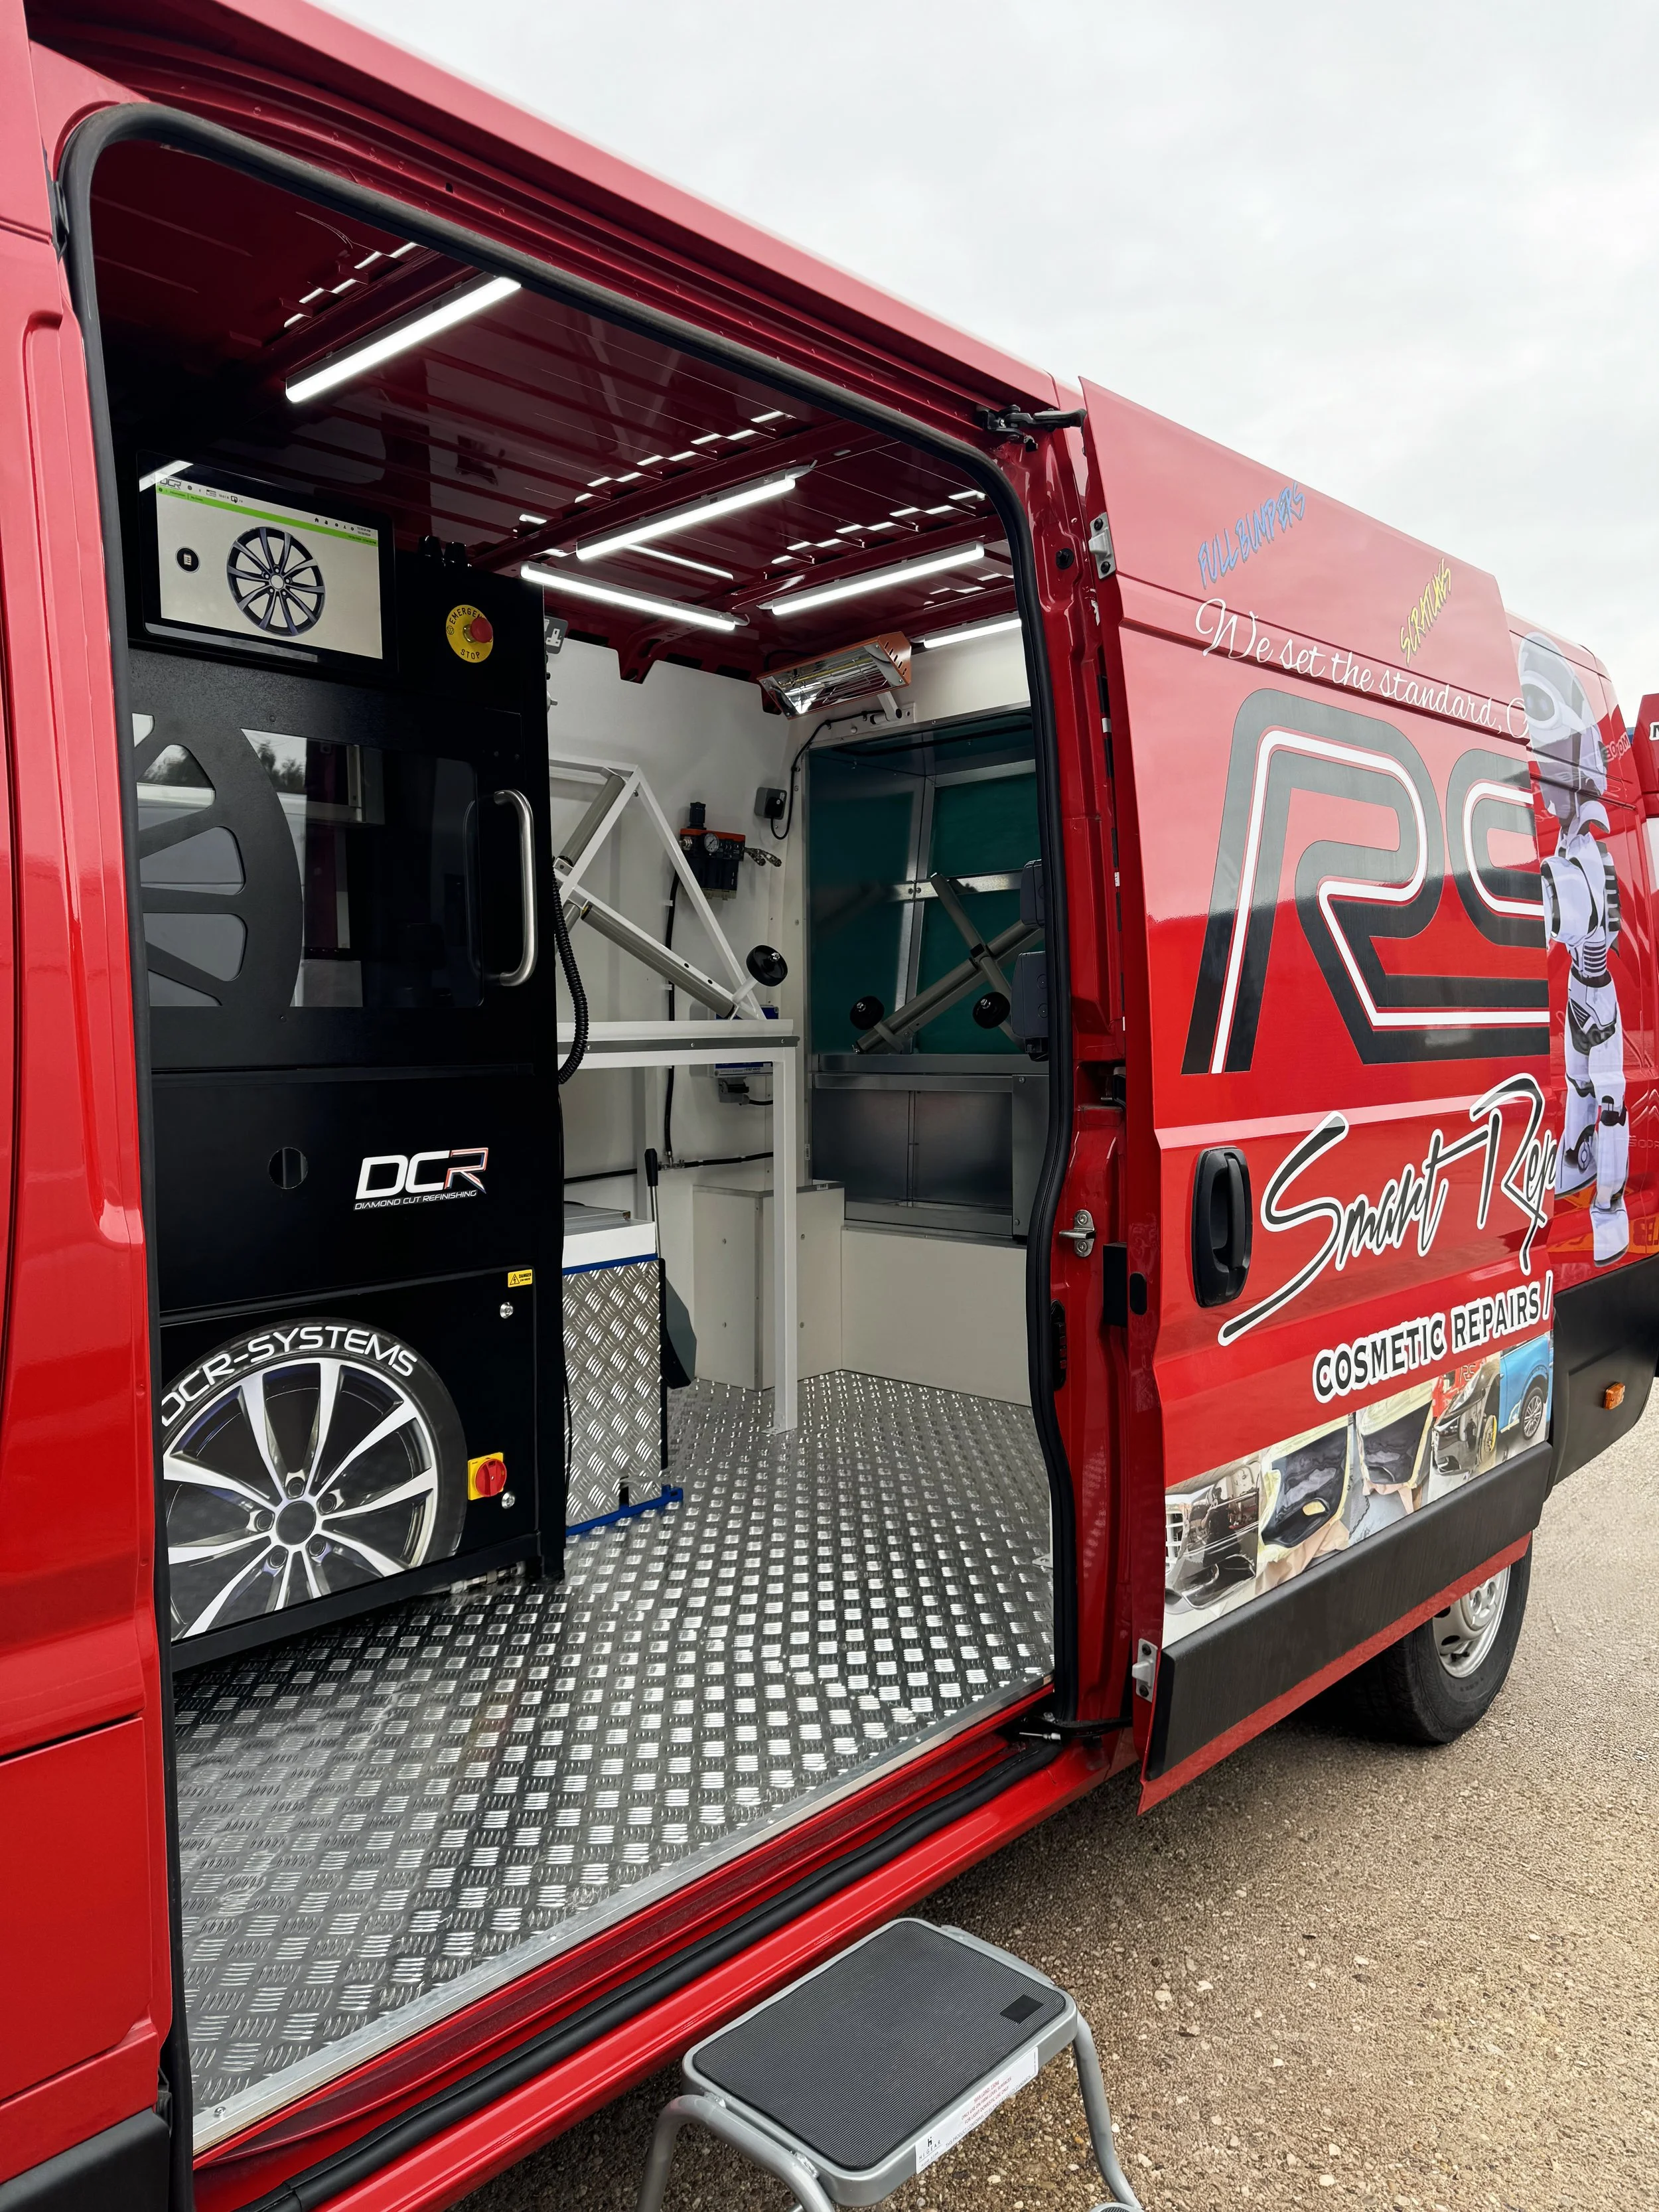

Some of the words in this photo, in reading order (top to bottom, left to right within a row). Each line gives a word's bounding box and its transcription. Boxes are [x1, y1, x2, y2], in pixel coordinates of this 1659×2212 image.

[1197, 528, 1239, 590] FULL
[1235, 480, 1306, 563] BUMPERS
[460, 648, 480, 660] STOP
[1195, 597, 1274, 663] We
[1279, 638, 1327, 678] set
[1331, 651, 1374, 692] the
[1378, 669, 1503, 735] standard,
[354, 1199, 401, 1211] DIAMOND
[403, 1196, 421, 1205] CUT
[422, 1190, 477, 1203] REFINISHING
[355, 1147, 489, 1200] DCR
[1217, 1110, 1489, 1347] Smart
[1313, 1312, 1446, 1404] COSMETIC
[1451, 1281, 1541, 1354] REPAIRS
